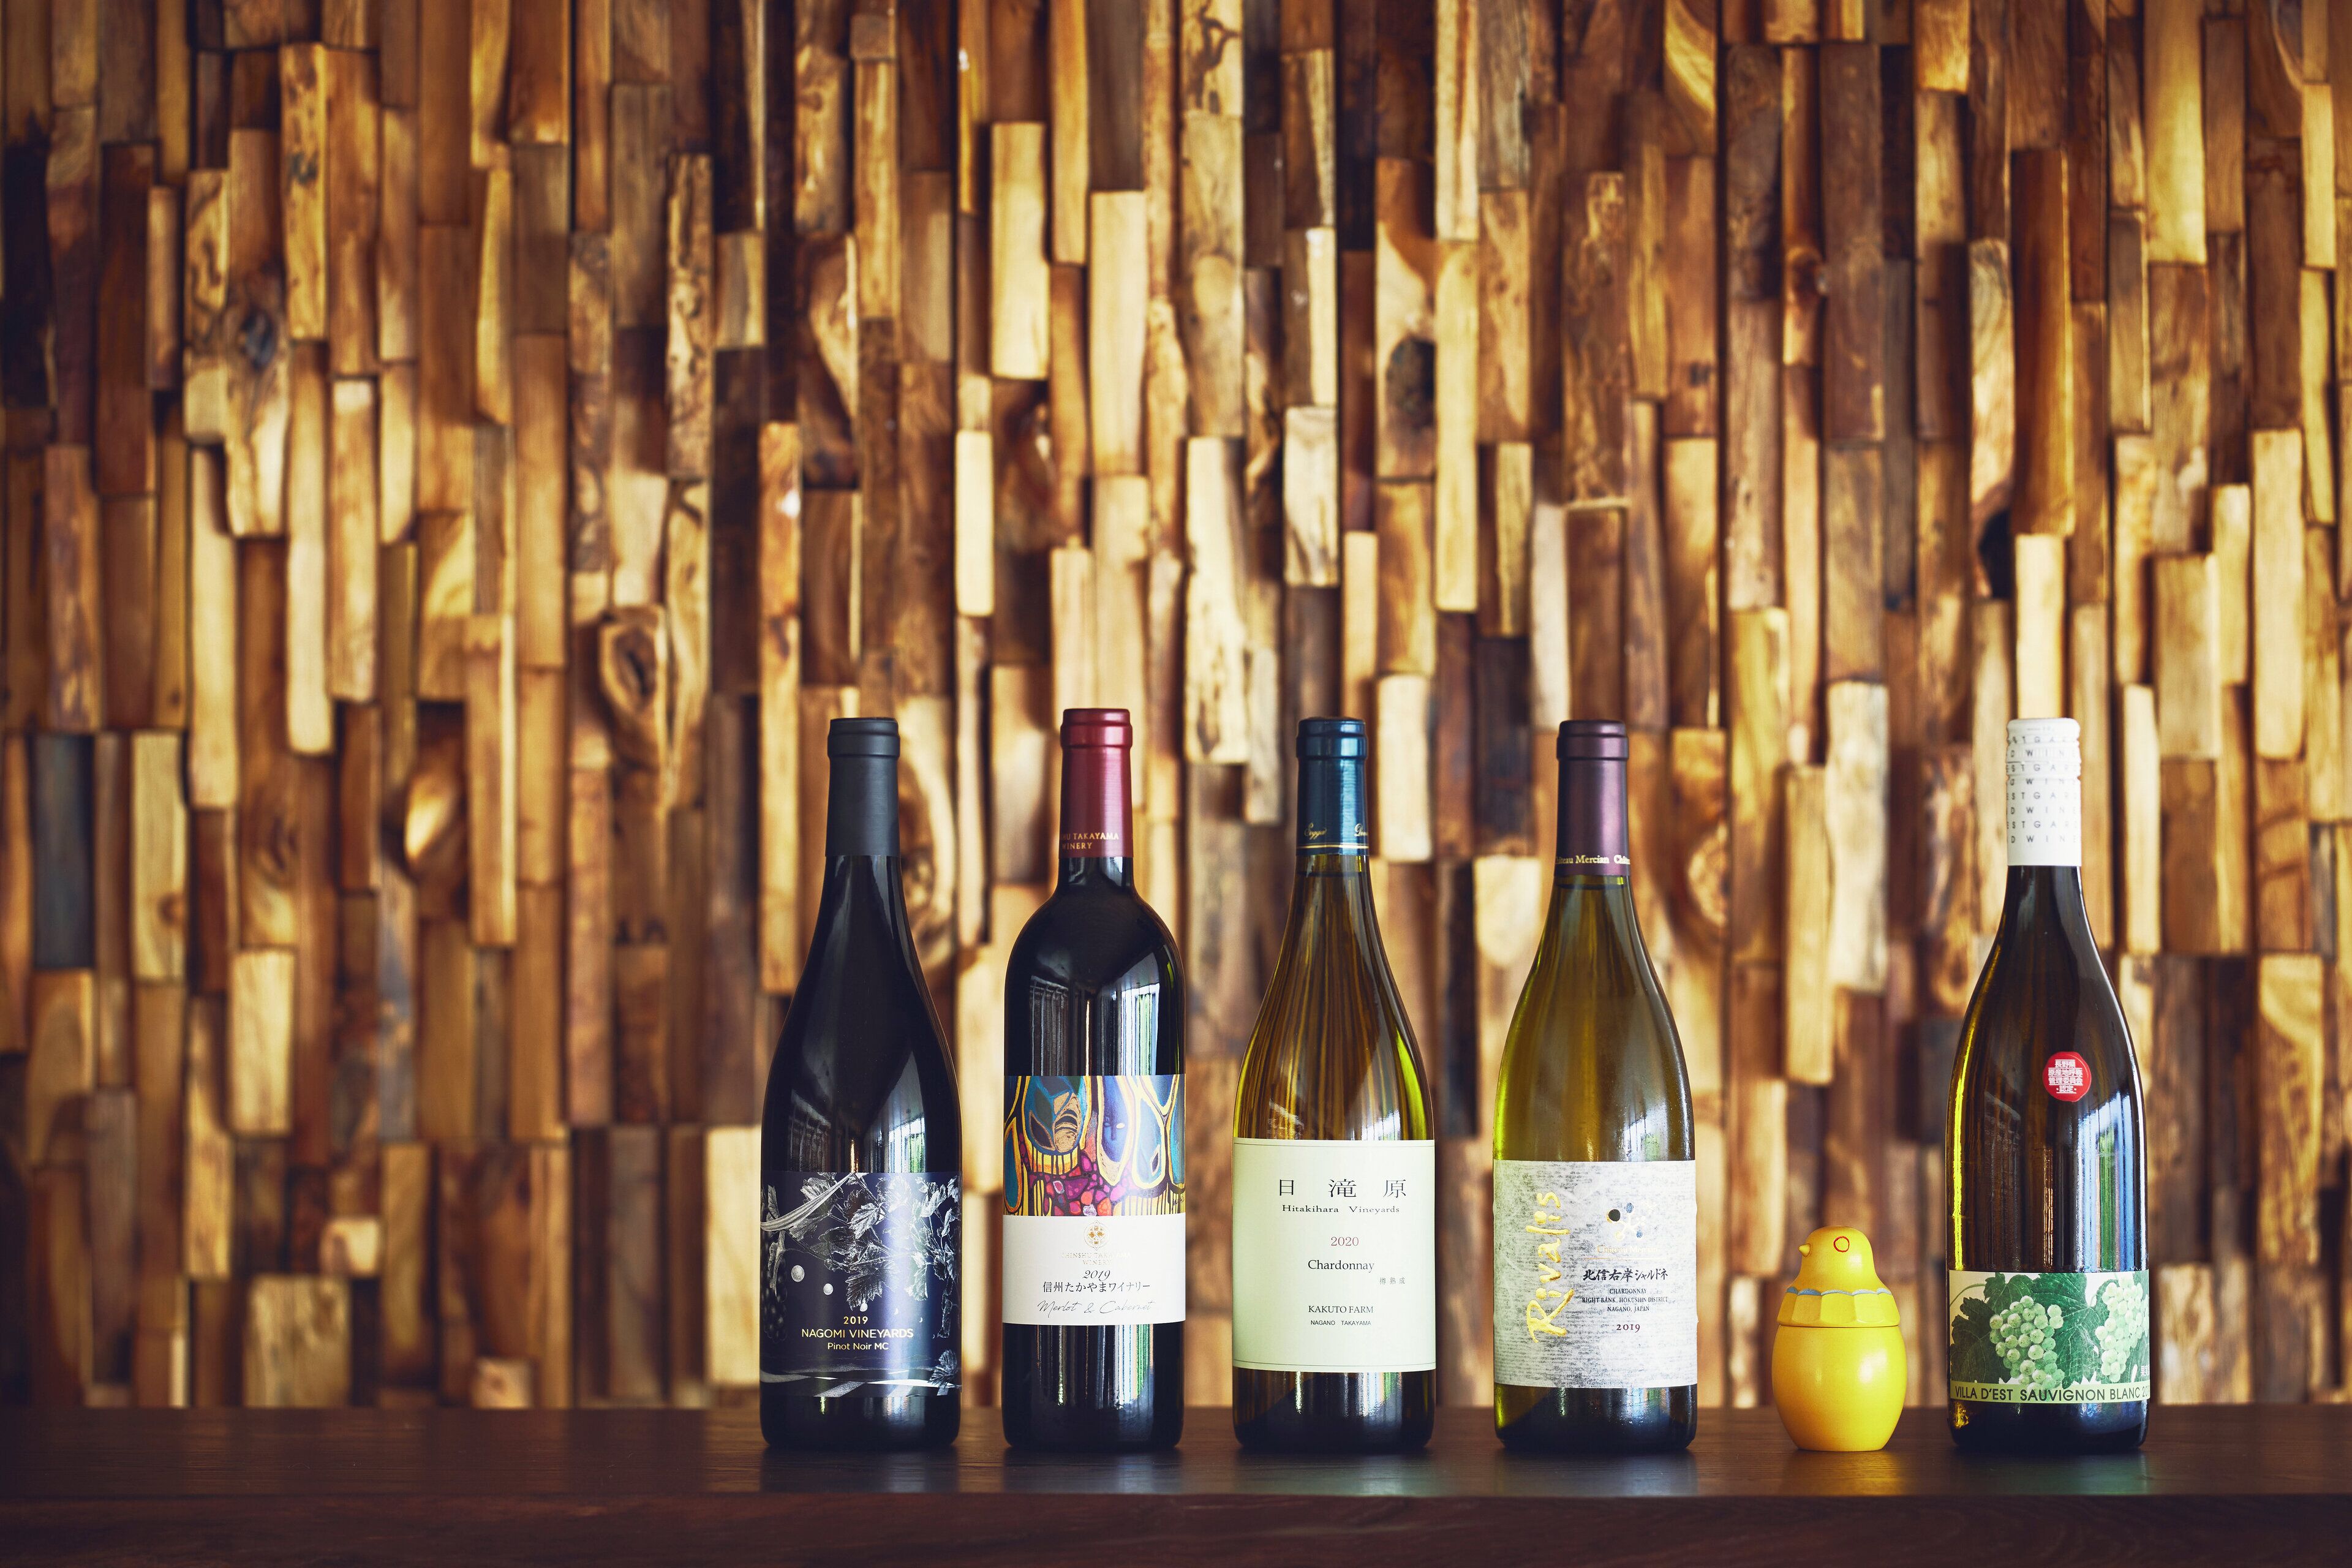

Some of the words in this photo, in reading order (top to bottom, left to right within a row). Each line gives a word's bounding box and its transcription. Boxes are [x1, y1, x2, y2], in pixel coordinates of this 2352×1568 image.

[1575, 855, 1610, 864] Mercian
[1349, 1205, 1400, 1215] Vineyards
[1331, 1237, 1359, 1246] 2020
[1308, 1260, 1374, 1273] Chardonnay
[1525, 1192, 1575, 1343] Rivalis
[1082, 1270, 1110, 1281] 2019
[1583, 1268, 1668, 1282] 北信右岸シャルドネ
[1042, 1281, 1150, 1292] 信州たかやまワイナリー
[1037, 1300, 1082, 1317] Merlot
[1084, 1303, 1095, 1314] &
[1099, 1300, 1156, 1314] Cabernet
[802, 1329, 845, 1338] NAGOMI
[850, 1329, 914, 1338] VINEYARDS
[1616, 1324, 1640, 1333] 2019
[1955, 1385, 1977, 1398] VILLA
[1981, 1388, 2013, 1401] D'EST
[2020, 1389, 2105, 1401] SAUVIGNON
[2110, 1387, 2140, 1400] BLANC
